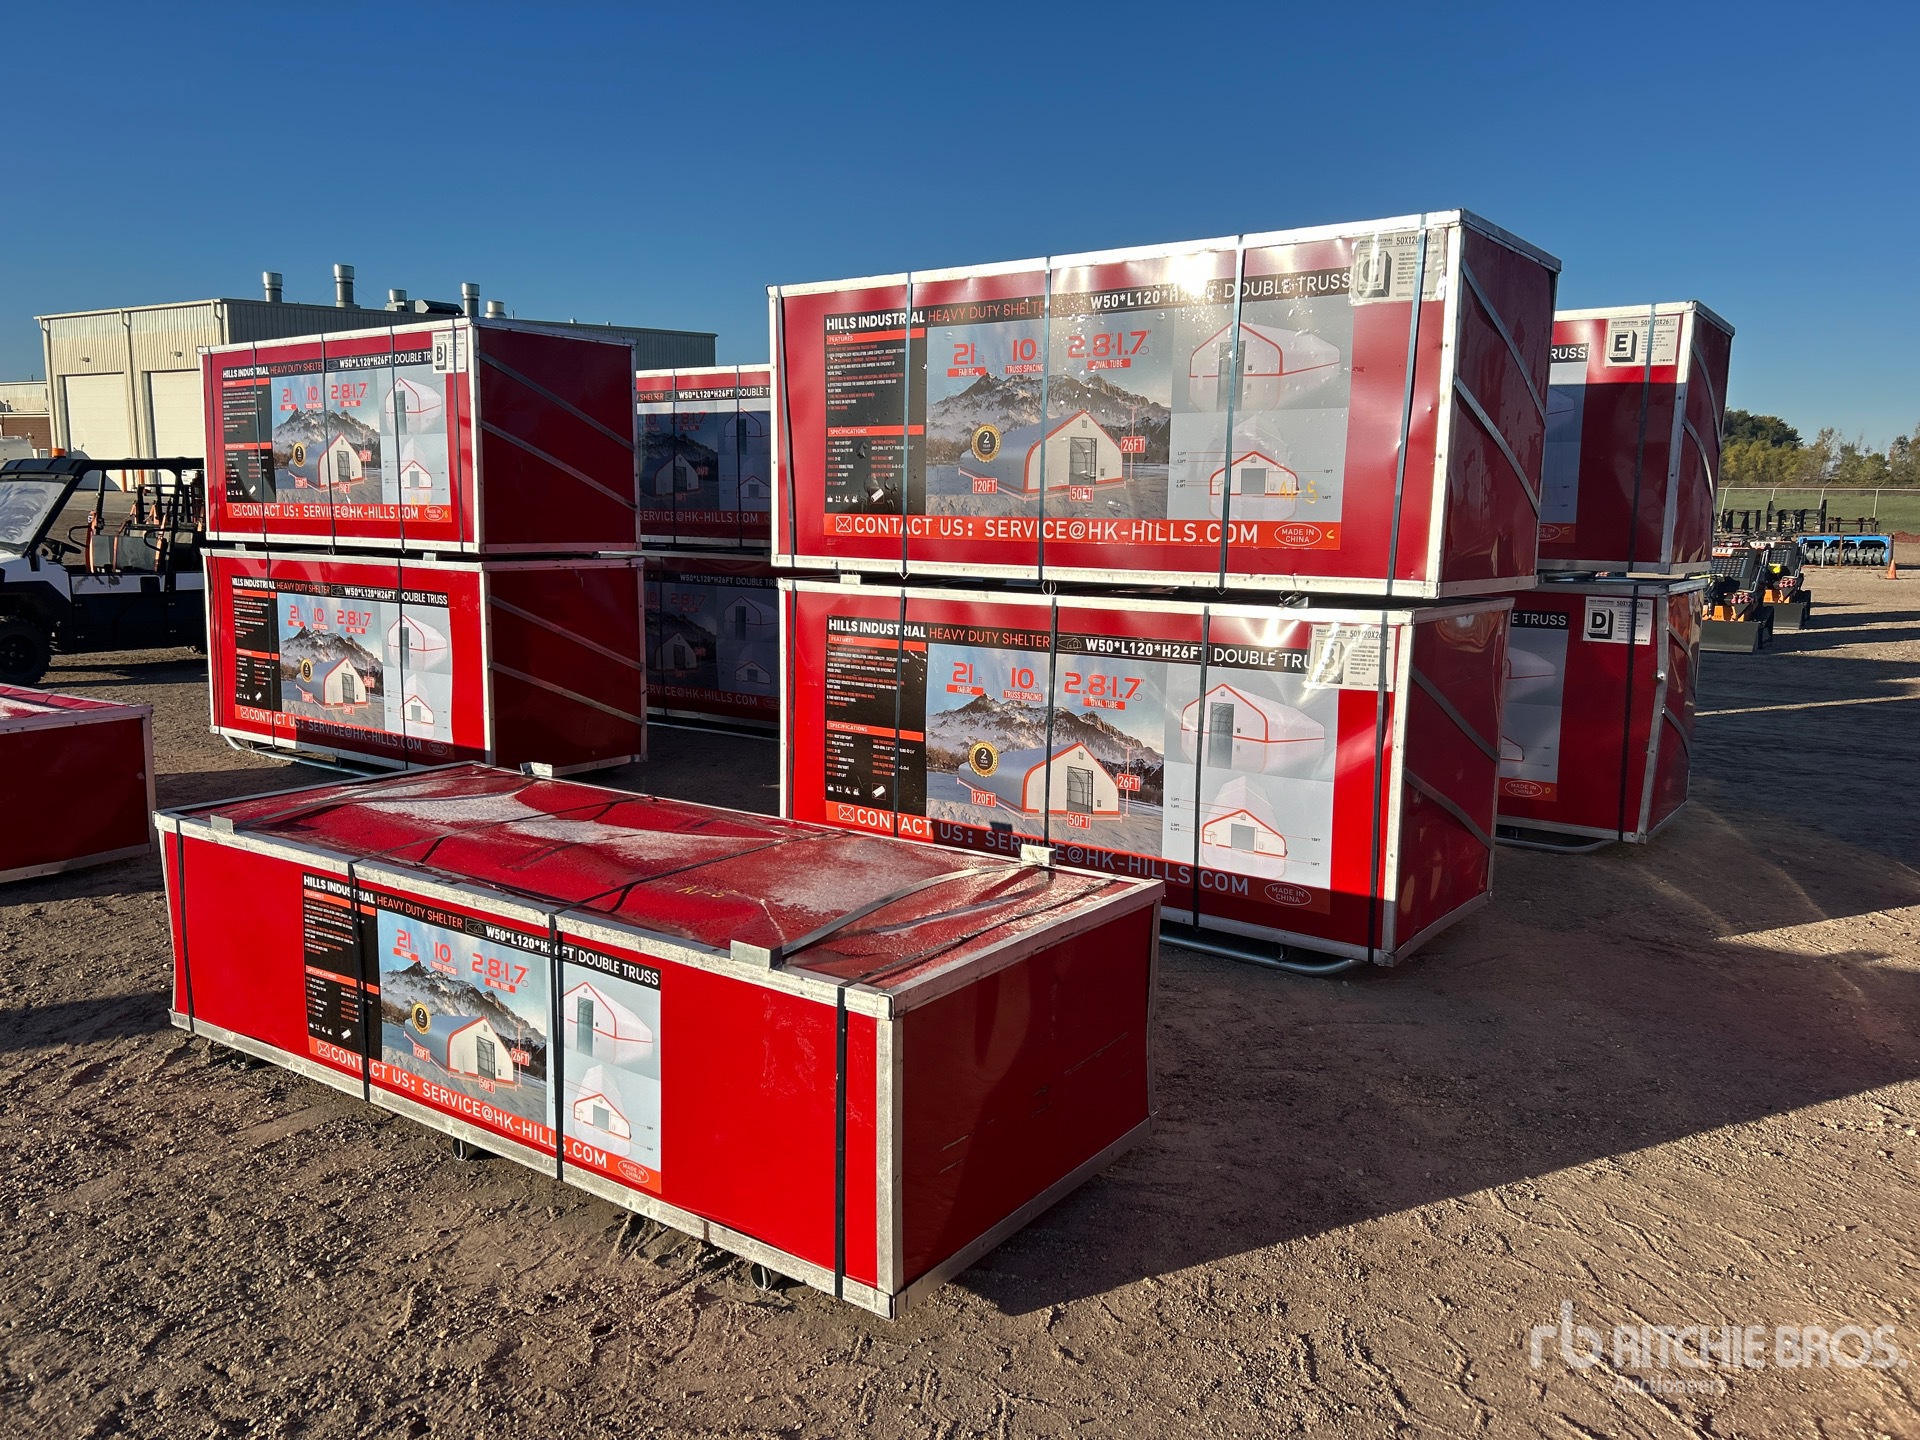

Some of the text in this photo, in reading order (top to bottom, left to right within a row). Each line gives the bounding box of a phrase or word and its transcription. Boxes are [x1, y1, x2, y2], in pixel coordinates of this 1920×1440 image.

[826, 317, 856, 331] HILLS
[859, 310, 925, 329] INDUSTRAL
[928, 308, 966, 322] HEAVY
[969, 304, 1000, 319] DUTY
[1003, 300, 1044, 317] SHELTE
[1224, 276, 1291, 299] DOUBLE
[1297, 271, 1351, 293] TRUSS
[1012, 338, 1037, 361] 10
[1613, 333, 1628, 352] E
[436, 345, 443, 360] B
[953, 342, 976, 366] 21
[1551, 347, 1587, 360] RUSS
[222, 368, 237, 379] HILLS
[270, 365, 287, 375] HEAVY
[288, 363, 302, 373] DUTY
[394, 351, 422, 364] DOUBLE
[1006, 364, 1022, 374] TRUSS
[1109, 359, 1123, 368] TUBE
[282, 388, 292, 403] 21
[307, 386, 318, 401] 10
[830, 427, 867, 436] SPECIFICATIONS
[984, 432, 990, 444] 2
[1122, 437, 1145, 452] 26FT
[973, 479, 996, 493] 120FT
[1071, 486, 1093, 500] 50FT
[241, 505, 281, 517] CONTACT
[303, 505, 419, 520] SERVICE@HK-HILLS.COM
[854, 516, 1258, 544] CONTACT US: SERVICE@HK-HILLS.COM
[1281, 528, 1315, 536] MADE IN
[1285, 535, 1310, 544] CHINA
[735, 577, 763, 587] DOUBLE
[276, 582, 295, 591] HEAVY
[295, 583, 308, 592] DUTY
[308, 584, 330, 594] SHELTER
[401, 591, 426, 603] OUBLE
[426, 593, 448, 605] TRUSS
[289, 605, 299, 619] 21
[313, 607, 325, 622] 10
[1523, 613, 1567, 626] TRUSS
[1591, 611, 1607, 629] D
[828, 619, 858, 632] HILLS
[859, 621, 927, 638] INDUSTRIAL
[929, 627, 966, 641] HEAVY
[968, 630, 999, 644] DUTY
[1002, 631, 1050, 648] SHELTER
[1214, 647, 1276, 667] DOUBLE
[952, 661, 974, 684] 21
[1010, 667, 1035, 689] 10
[645, 685, 758, 706] ERVICE@HK-HILLS.COM
[1004, 690, 1042, 702] TRUSS SPACING
[1090, 698, 1118, 709] OVAL TUBE
[249, 708, 286, 725] CONTACT
[308, 719, 422, 751] SERVICE@HK-HILLS.COM
[829, 721, 868, 733] SPECIFICATIONS
[980, 748, 987, 759] 2
[1118, 775, 1140, 790] 26FT
[972, 790, 996, 806] 120FT
[1068, 813, 1090, 828] 50FT
[1271, 886, 1305, 898] MADE IN
[1275, 893, 1301, 904] CHINA
[303, 875, 327, 890] HILLS
[376, 895, 404, 914] HEAVY
[405, 903, 425, 919] DUTY
[427, 910, 463, 929] SHELTER
[578, 949, 620, 975] DOUBLE
[622, 962, 660, 986] TRUSS
[397, 928, 412, 949] 21
[434, 941, 452, 963] 10
[419, 1008, 424, 1019] 2
[512, 1050, 530, 1066] 26FT
[331, 1047, 388, 1078] CONTCT
[392, 1070, 416, 1092] US:
[480, 1077, 495, 1093] 50FT
[622, 1162, 639, 1174] MADE
[625, 1168, 642, 1181] CHINA
